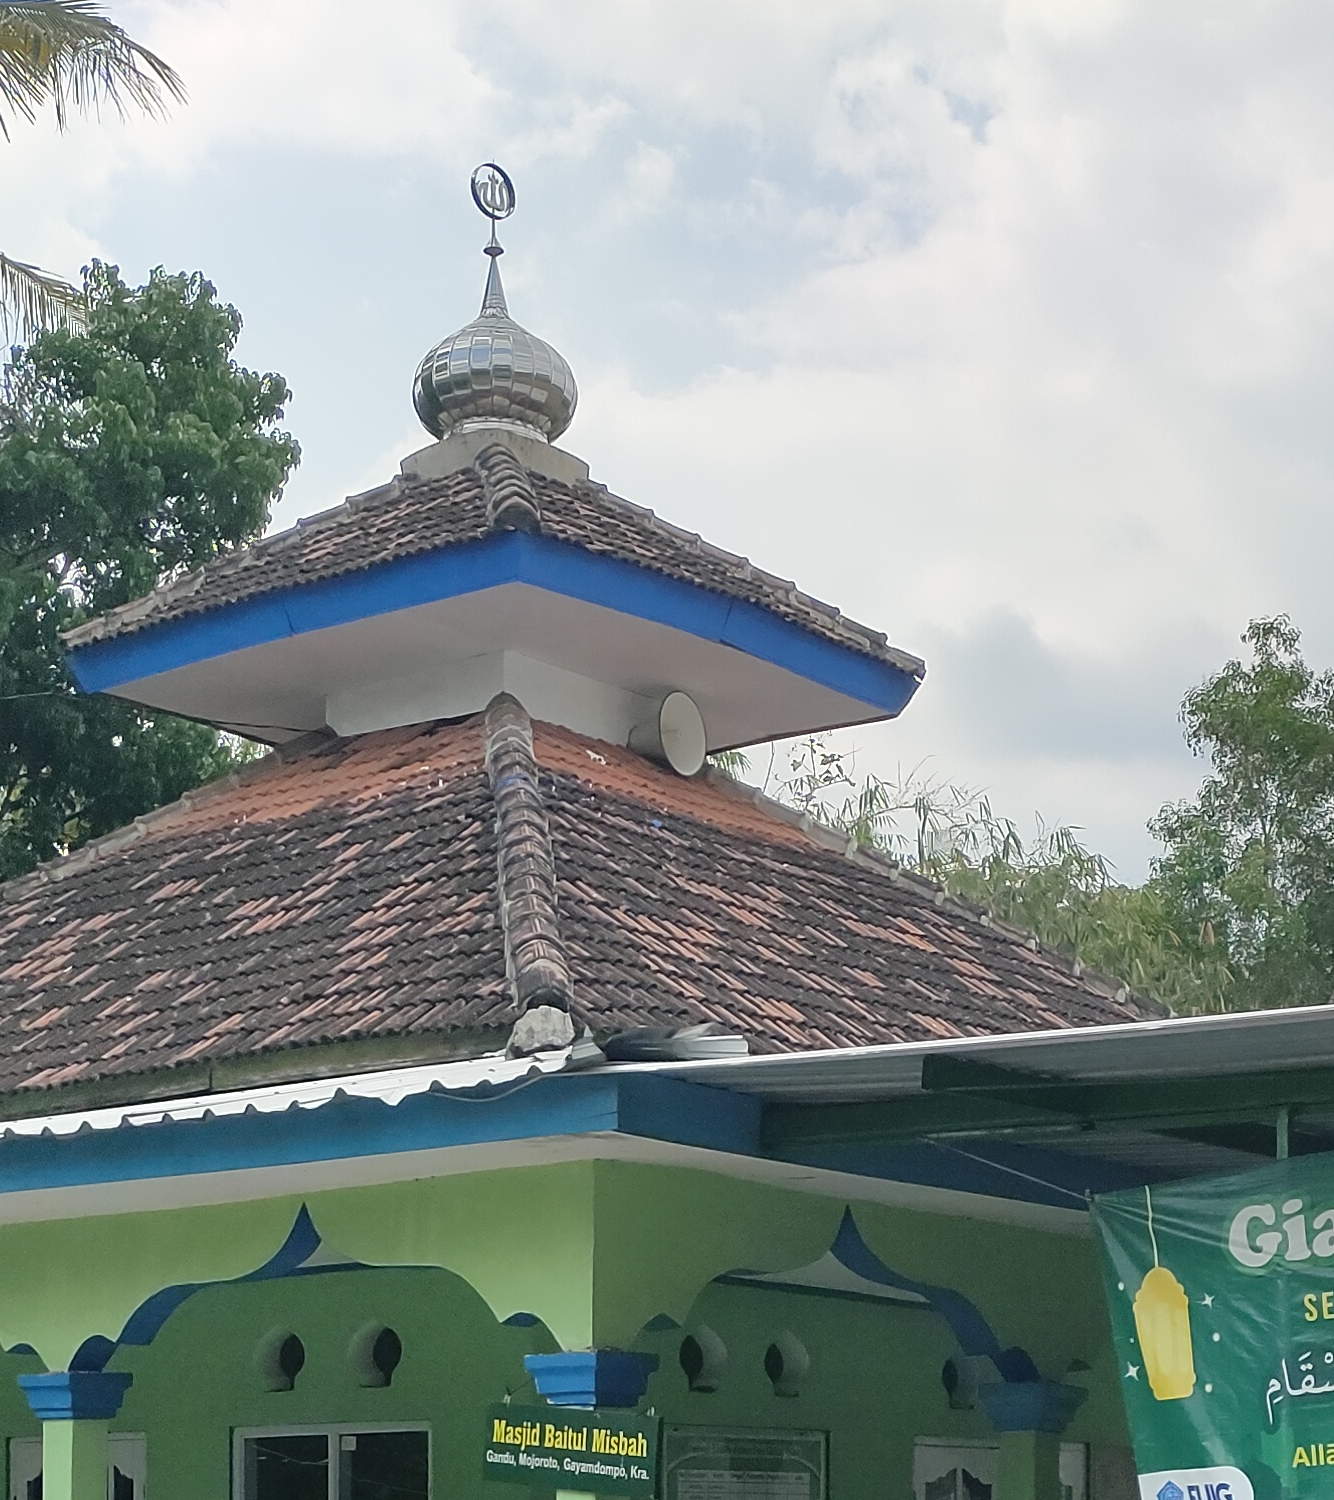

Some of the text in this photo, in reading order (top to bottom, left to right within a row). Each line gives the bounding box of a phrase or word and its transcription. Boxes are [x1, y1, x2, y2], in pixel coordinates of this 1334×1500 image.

[492, 1419, 648, 1458] Masjid Baitul Misbah
[518, 1452, 560, 1472] Mojoroto,
[563, 1457, 628, 1480] Gayamdompo,
[630, 1464, 650, 1480] Kra.
